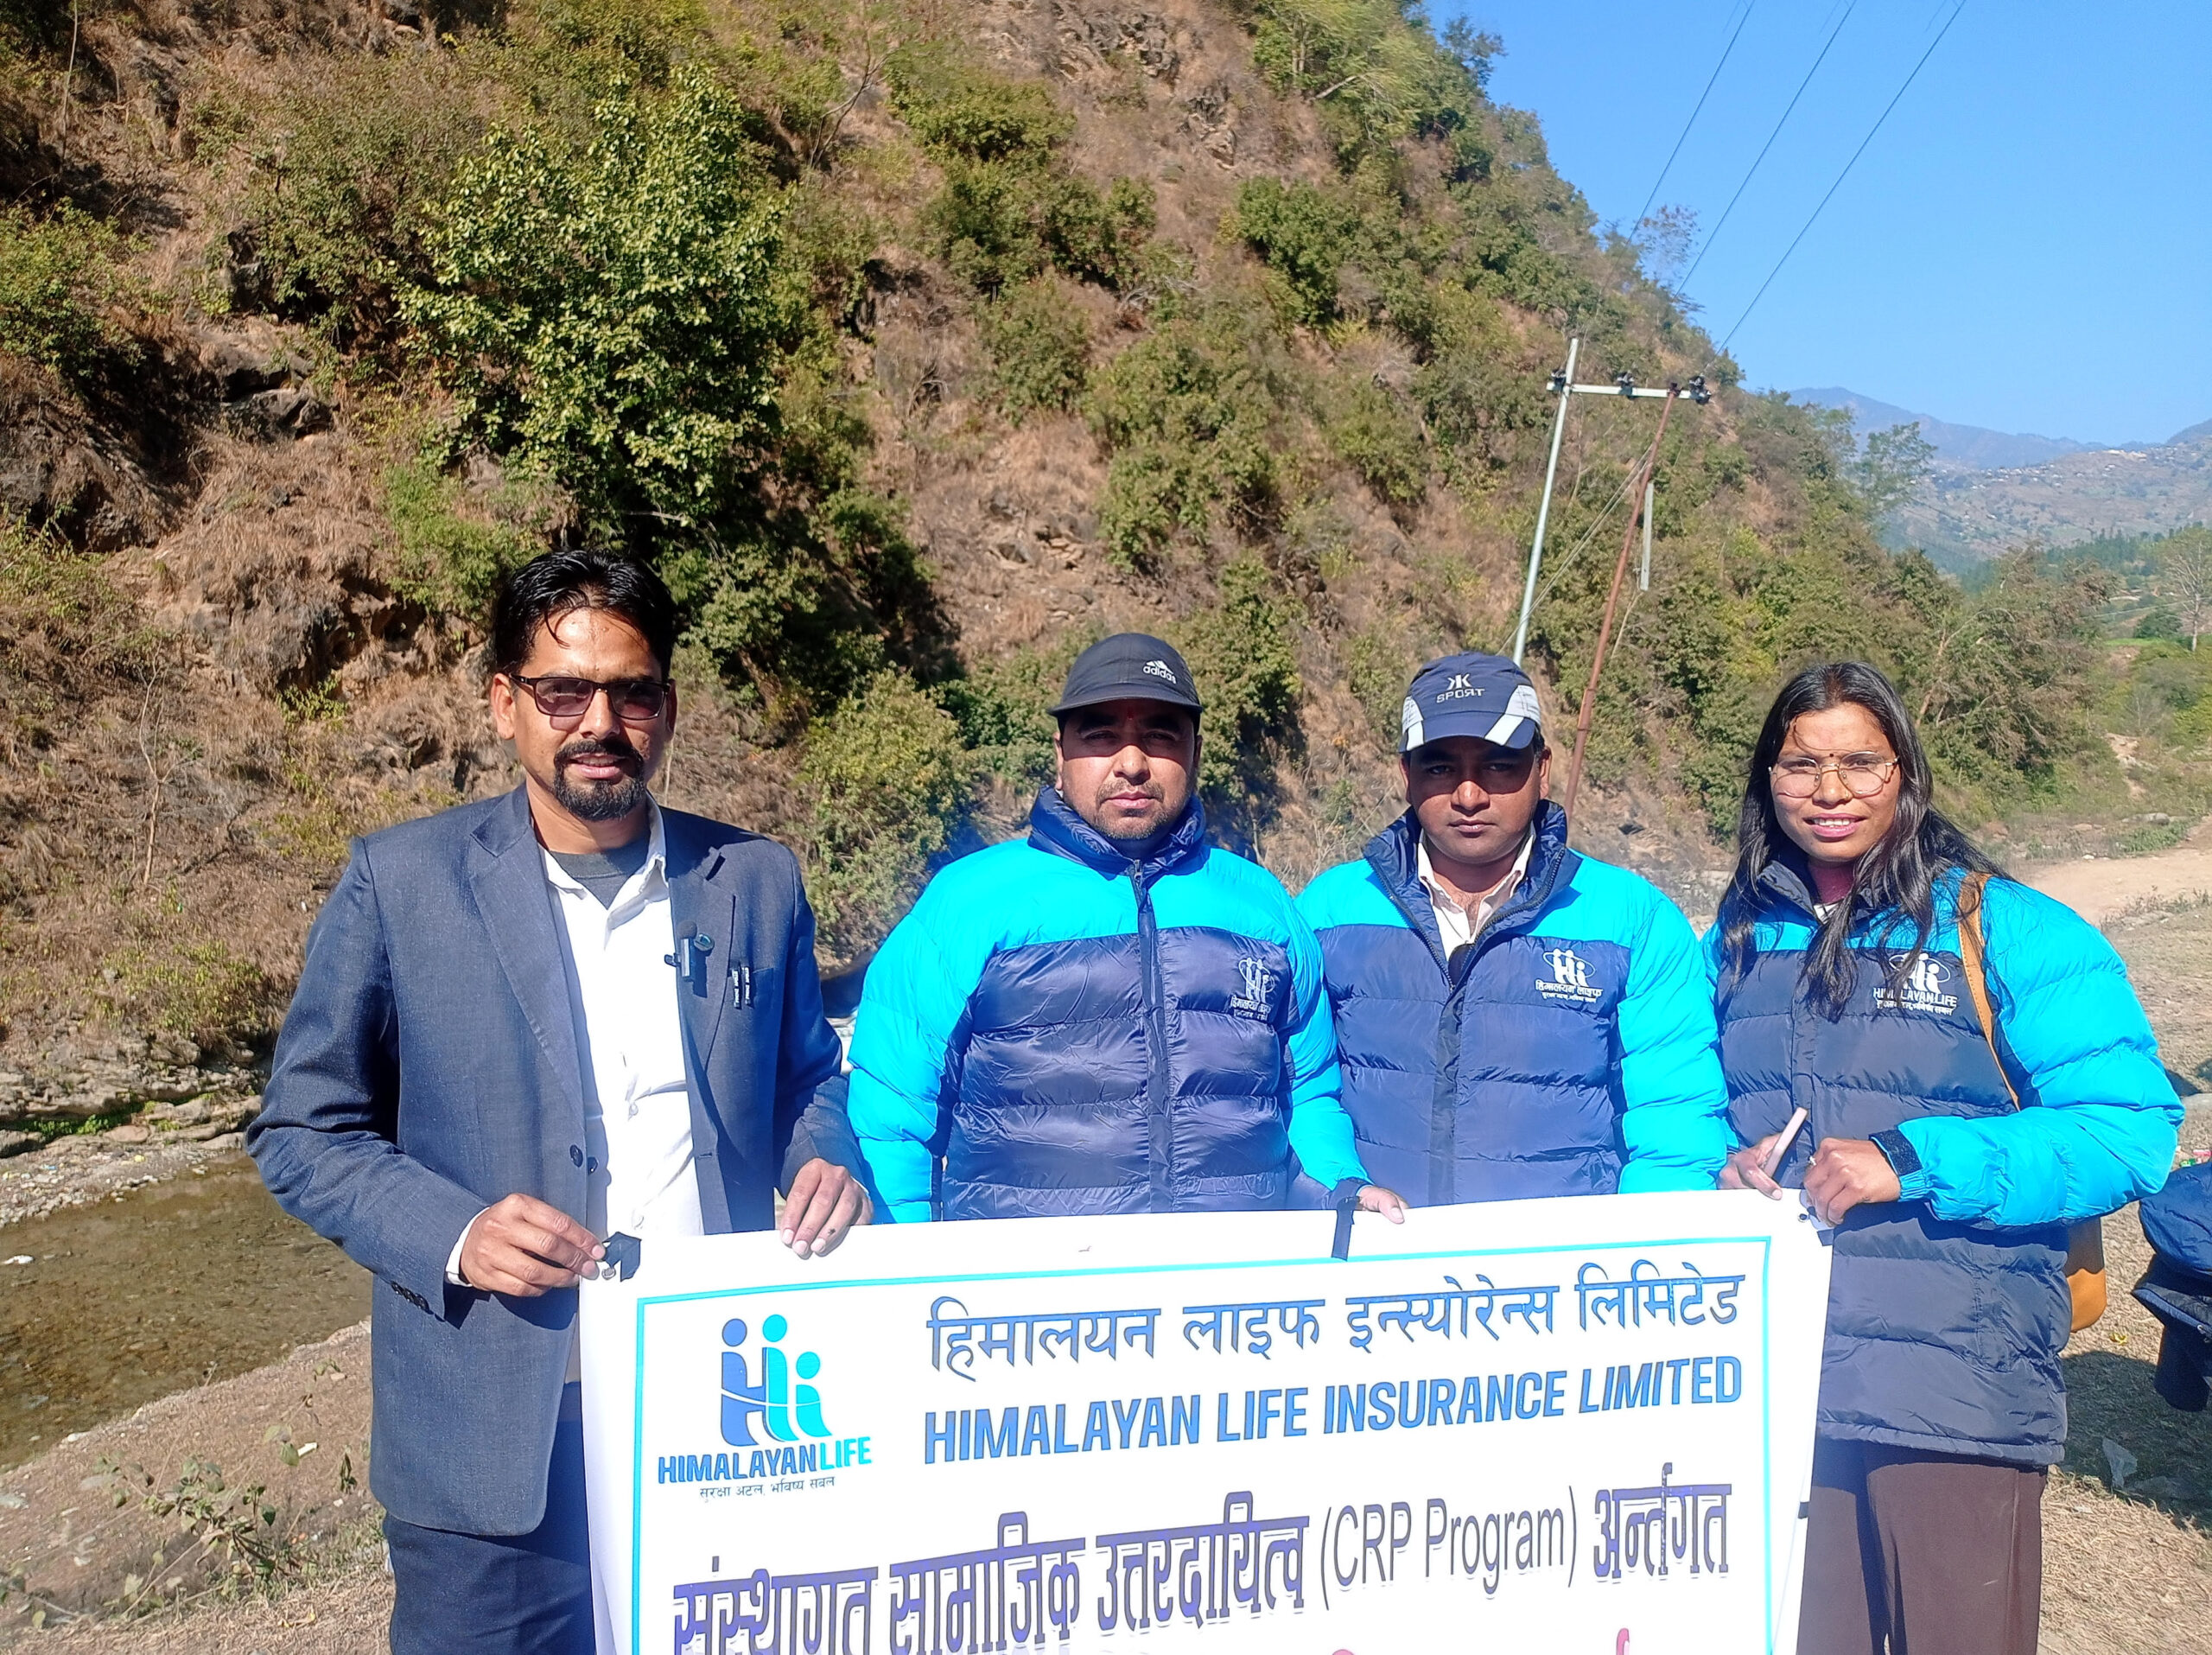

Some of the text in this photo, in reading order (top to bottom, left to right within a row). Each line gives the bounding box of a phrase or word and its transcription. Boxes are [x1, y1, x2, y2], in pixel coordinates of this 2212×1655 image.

[1142, 665, 1177, 684] adidas
[926, 1259, 1745, 1382] हिमालयन लाइफ इन्स्योरेन्स लिमिटेड
[925, 1355, 1742, 1464] HIMALAYAN LIFE INSURANCE LIMITED
[700, 1486, 731, 1503] सुरक्षा
[771, 1478, 804, 1493] भविष्य
[674, 1556, 879, 1655] संस्थागत
[890, 1512, 1085, 1655] सामाजिक
[1096, 1491, 1310, 1631] उत्तरदायित्व
[1321, 1502, 1411, 1611] (CRP
[1426, 1486, 1577, 1595] Program)
